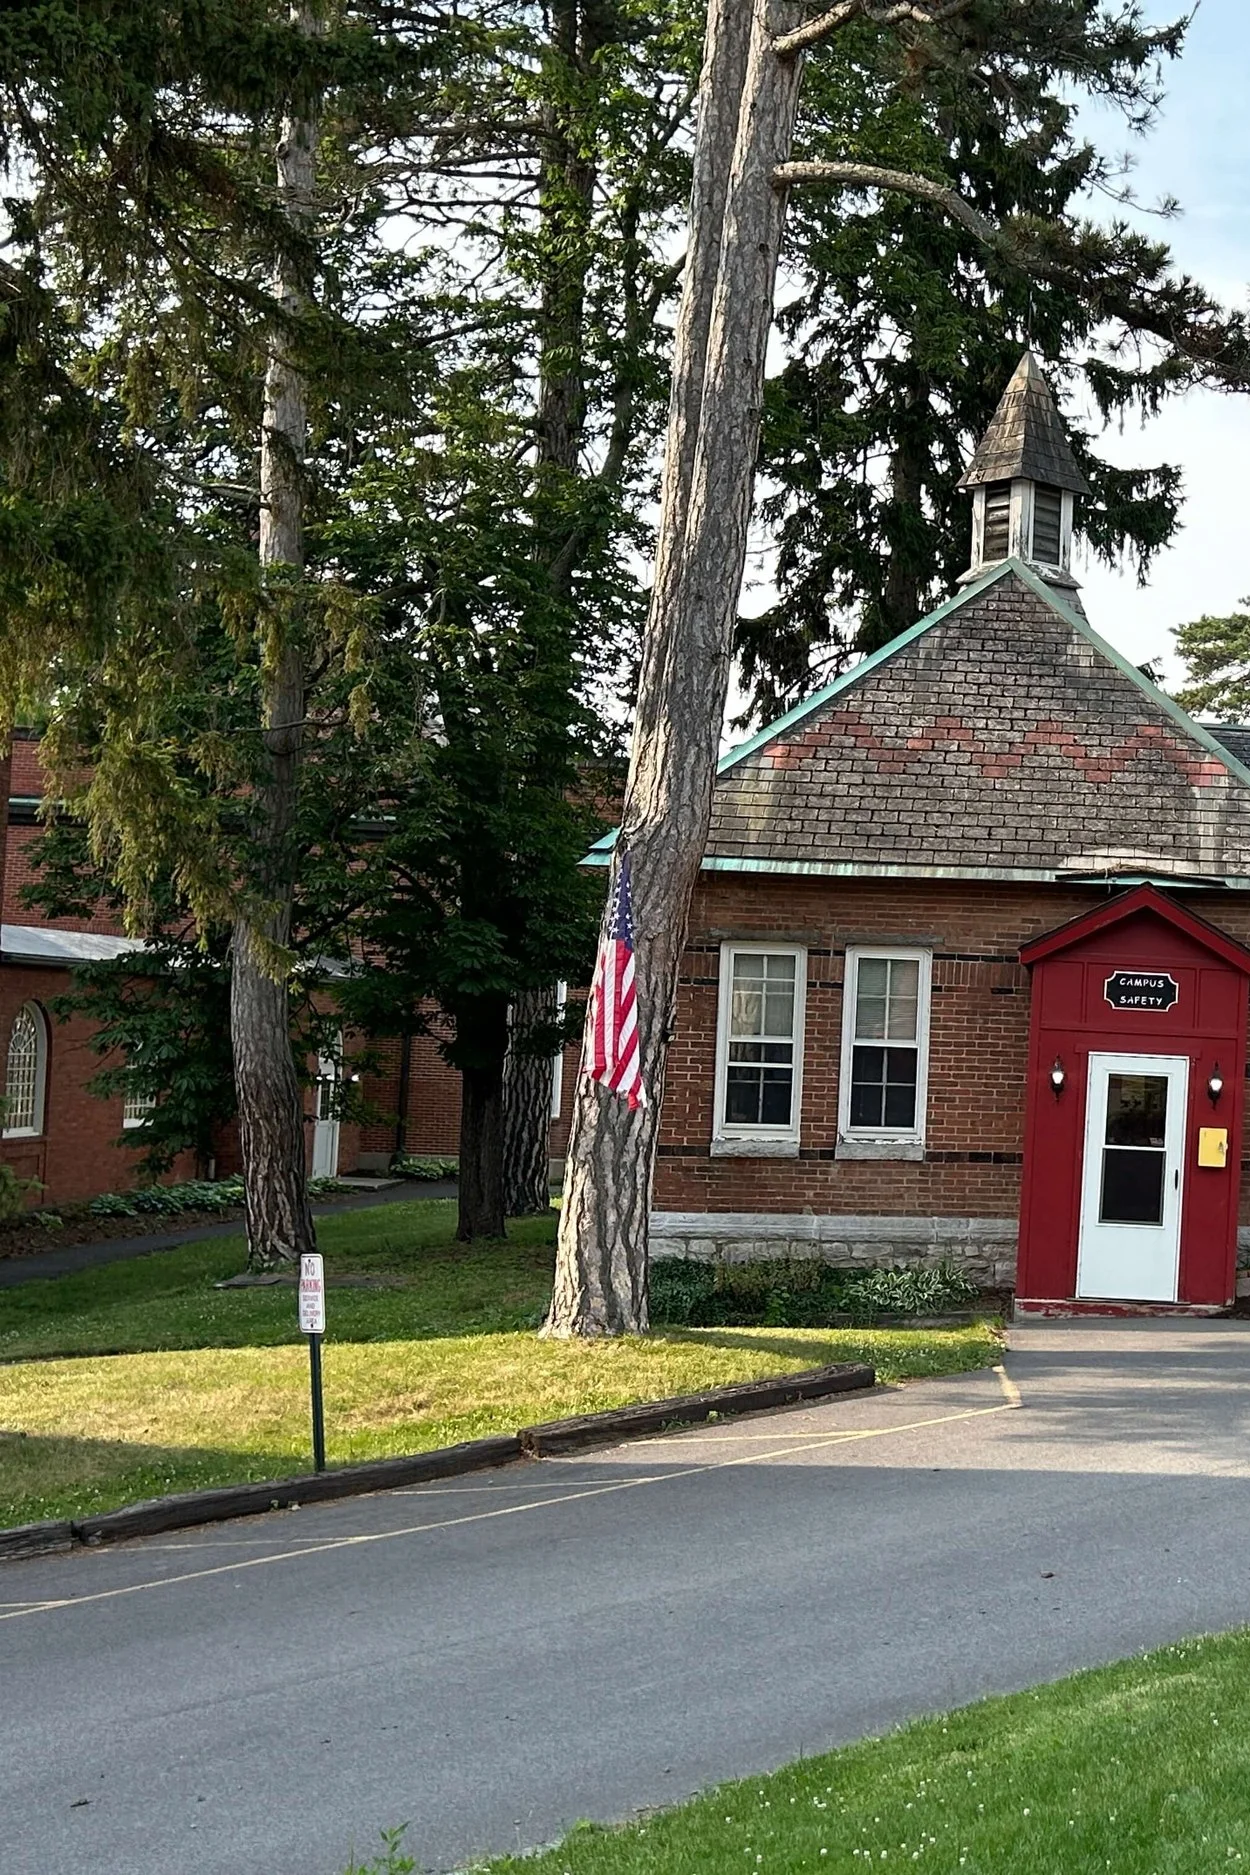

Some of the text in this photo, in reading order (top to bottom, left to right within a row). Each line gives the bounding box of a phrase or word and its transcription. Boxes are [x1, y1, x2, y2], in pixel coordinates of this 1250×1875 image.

[1119, 977, 1165, 988] CAMPUS
[1119, 995, 1163, 1006] SAFETY
[304, 1262, 316, 1276] NO
[301, 1279, 321, 1293] PARKING
